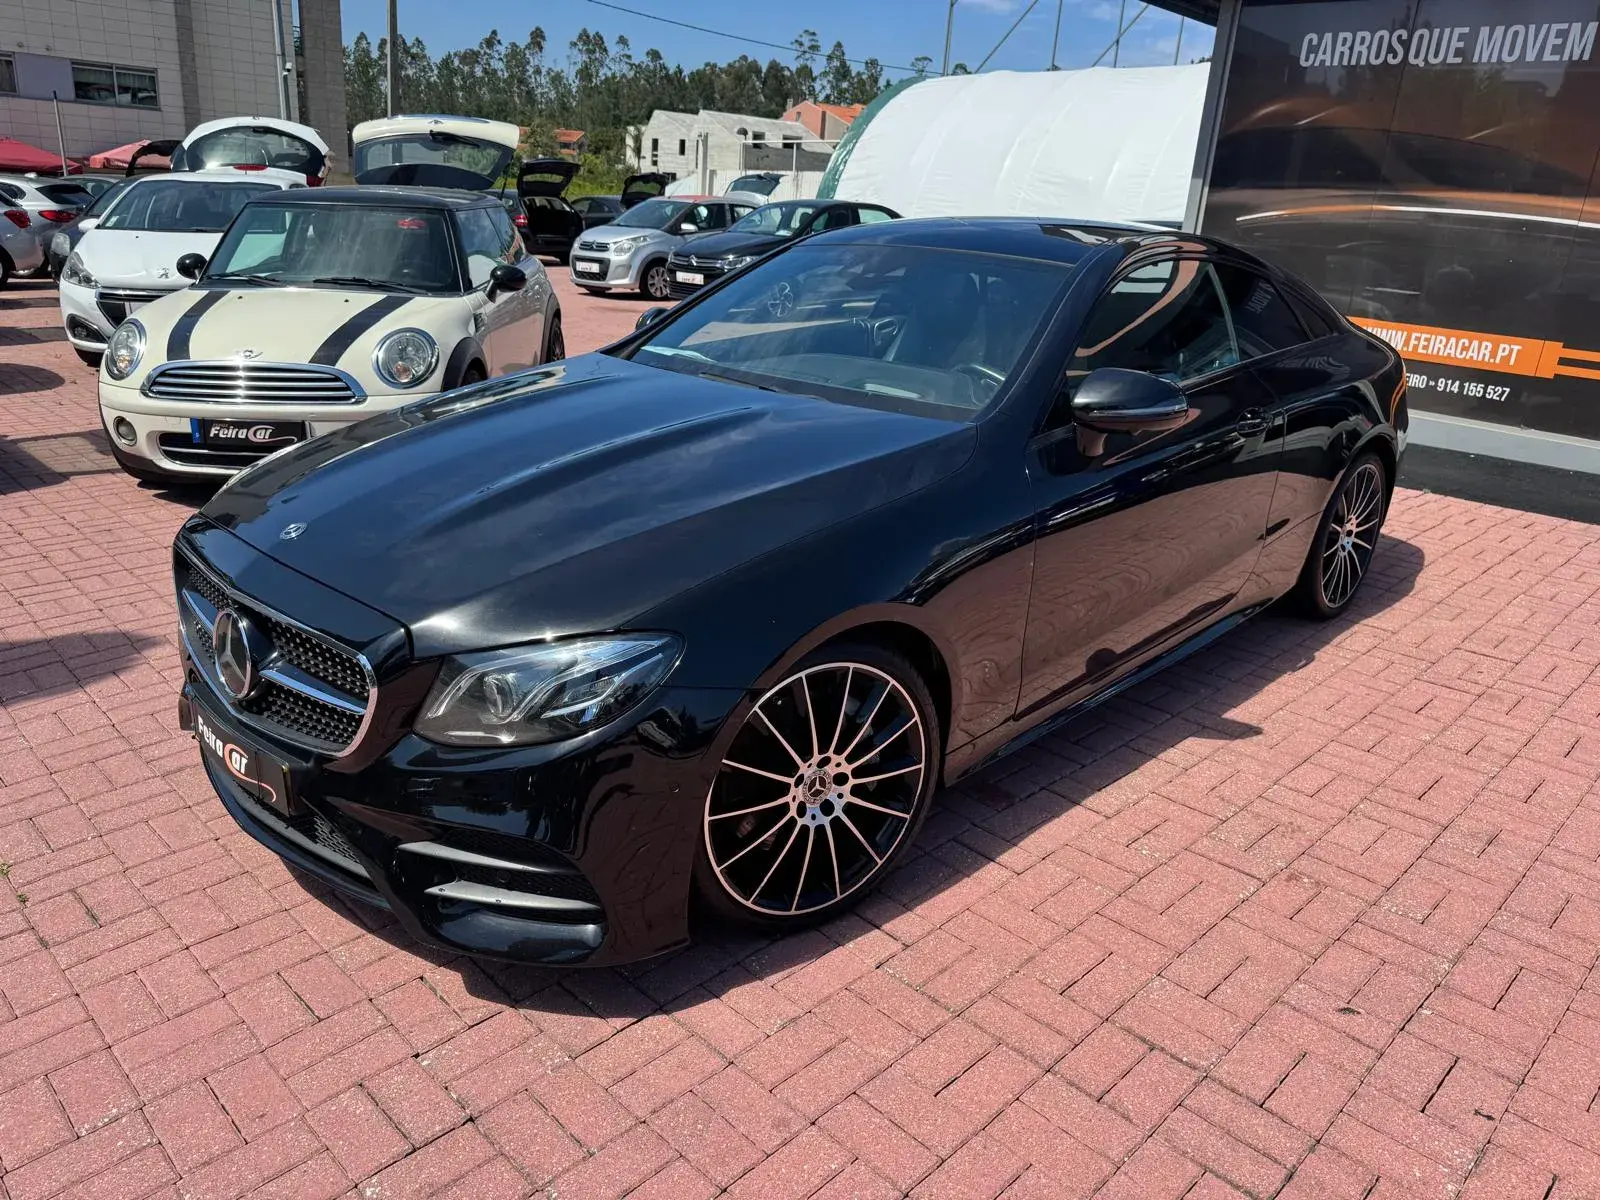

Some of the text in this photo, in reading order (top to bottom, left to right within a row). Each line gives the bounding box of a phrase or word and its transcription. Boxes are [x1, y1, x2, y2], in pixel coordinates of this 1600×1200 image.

[1299, 21, 1599, 68] CARROS QUE MOVEM
[1363, 326, 1522, 366] WW.FEIRACAR.PT
[1437, 378, 1460, 394] 914
[1463, 382, 1484, 397] 155
[1486, 385, 1510, 402] 527
